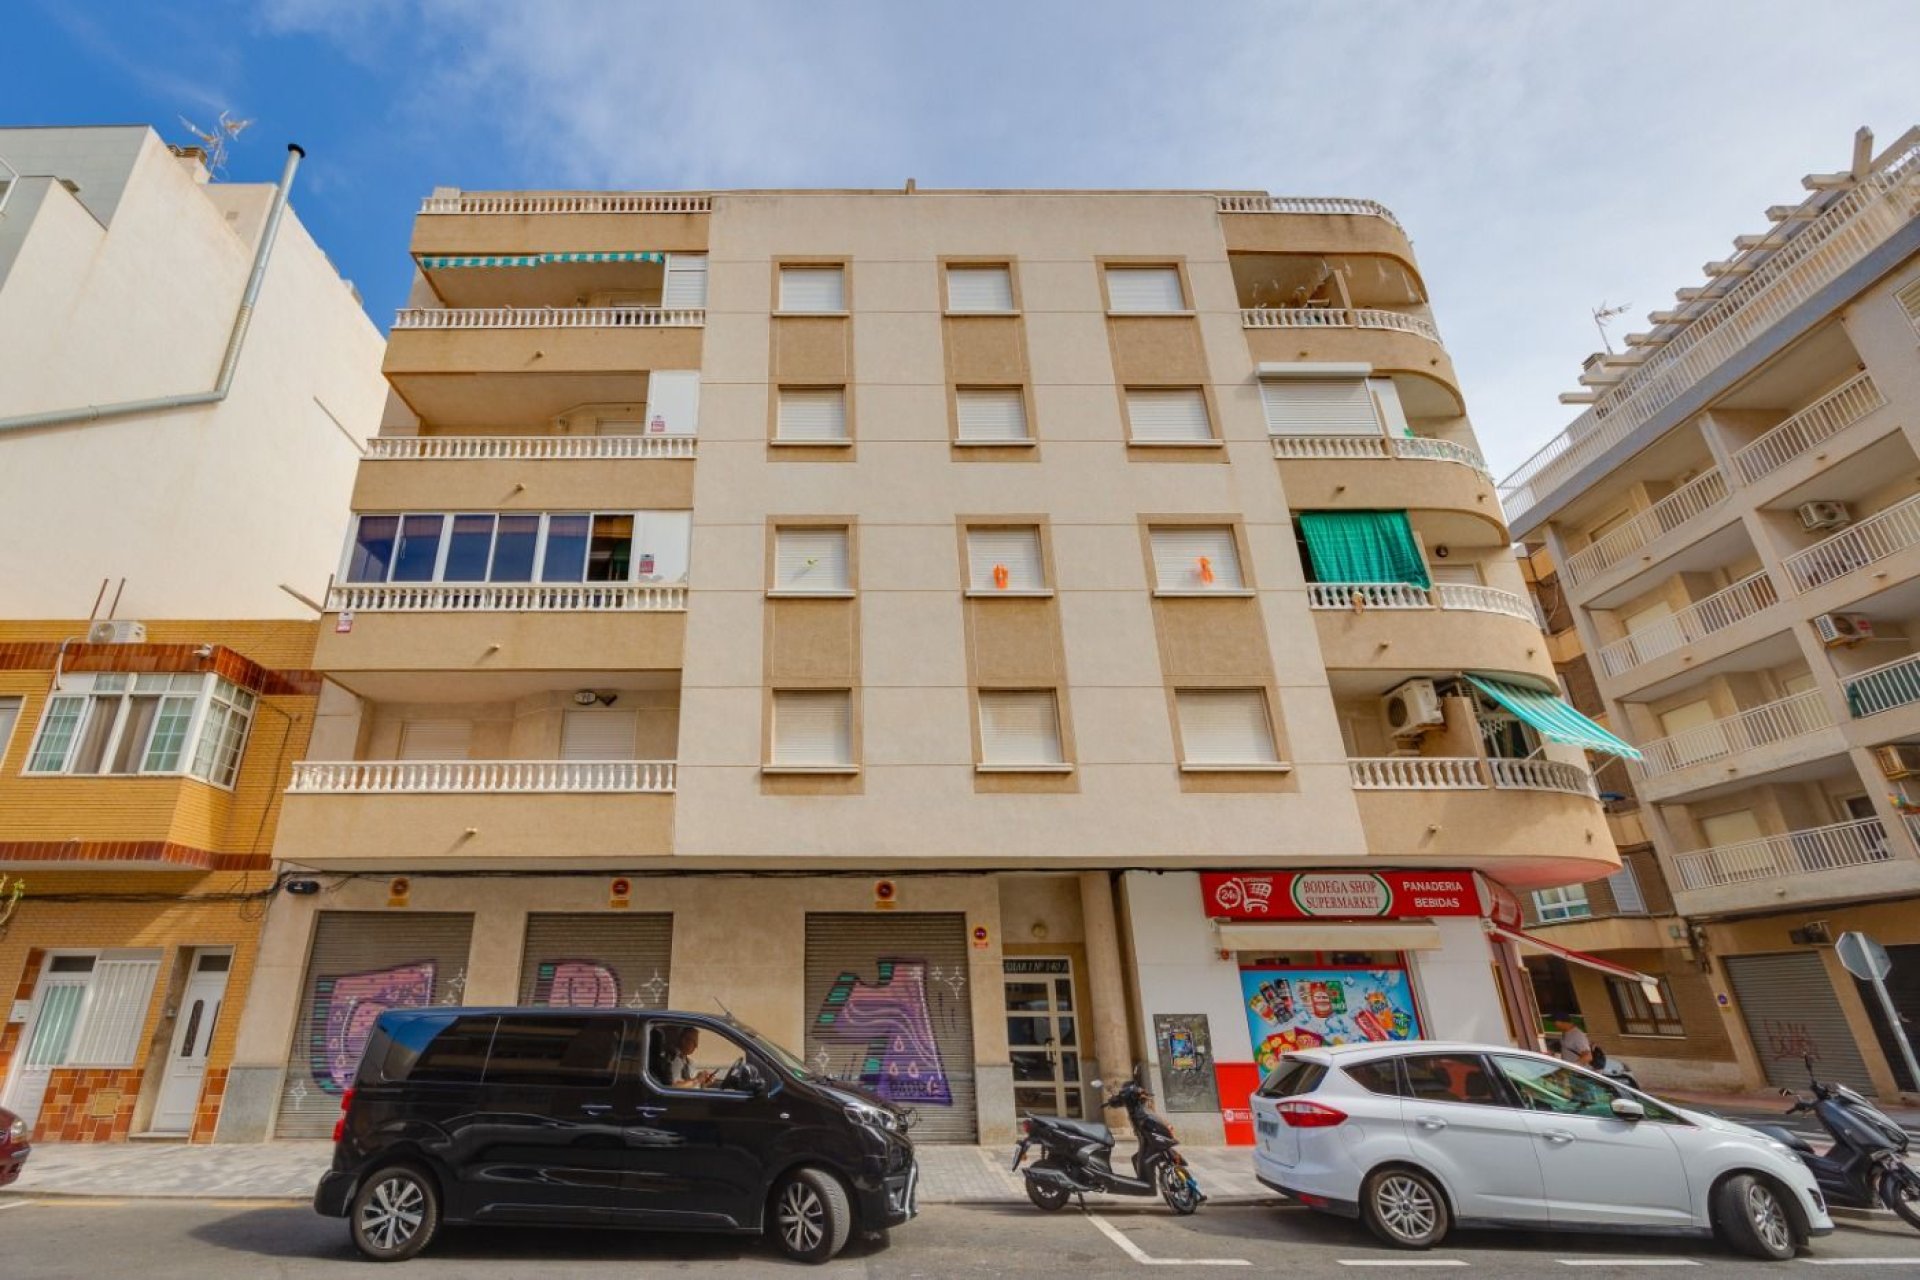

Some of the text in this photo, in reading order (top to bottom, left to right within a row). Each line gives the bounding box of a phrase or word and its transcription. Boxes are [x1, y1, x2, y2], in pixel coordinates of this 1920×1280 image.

[1303, 880, 1377, 894] BODEGA SHOP
[1402, 880, 1464, 893] PANADERIA
[1305, 895, 1380, 909] SUPERMARKET
[1414, 897, 1460, 908] BEBIDAS
